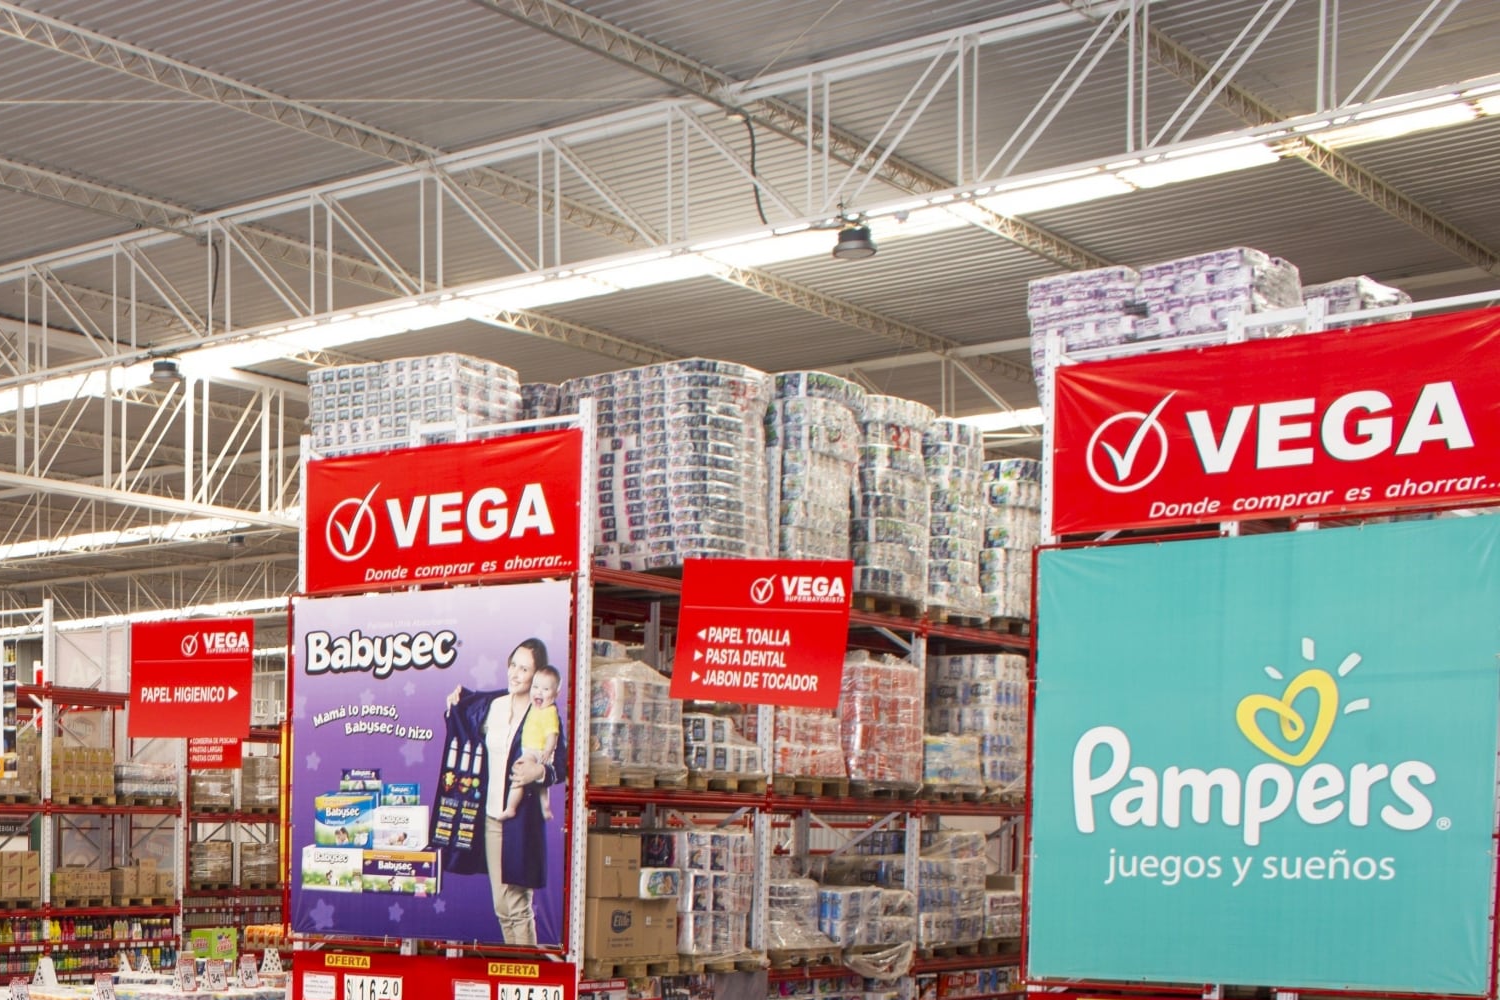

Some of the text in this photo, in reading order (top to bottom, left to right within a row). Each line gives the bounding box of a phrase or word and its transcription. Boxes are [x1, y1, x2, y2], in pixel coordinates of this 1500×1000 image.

[1185, 381, 1475, 475] VEGA
[1148, 474, 1500, 520] Donde comprar es ahorrar...
[386, 482, 556, 550] VEGA
[364, 554, 573, 582] Donde comprar es ahorrar...
[781, 576, 846, 597] VEGA
[785, 596, 845, 604] SUPERMAYORISTA
[203, 632, 250, 648] VEGA
[708, 626, 791, 646] PAPEL TOALLA
[305, 629, 458, 680] Babysec
[705, 648, 787, 668] PASTA DENTAL
[702, 670, 818, 691] JABON DE TOCADOR
[141, 686, 225, 703] PAPEL HIGIENICO
[313, 703, 399, 727] Mamá lo pensó,
[345, 721, 433, 741] Babysec lo hizo
[1072, 725, 1437, 846] Pampers
[325, 806, 360, 818] Babysec
[377, 860, 412, 872] Babysec
[1105, 848, 1396, 886] juegos y sueños
[327, 955, 369, 968] OFERTA
[490, 964, 538, 977] OFERTA
